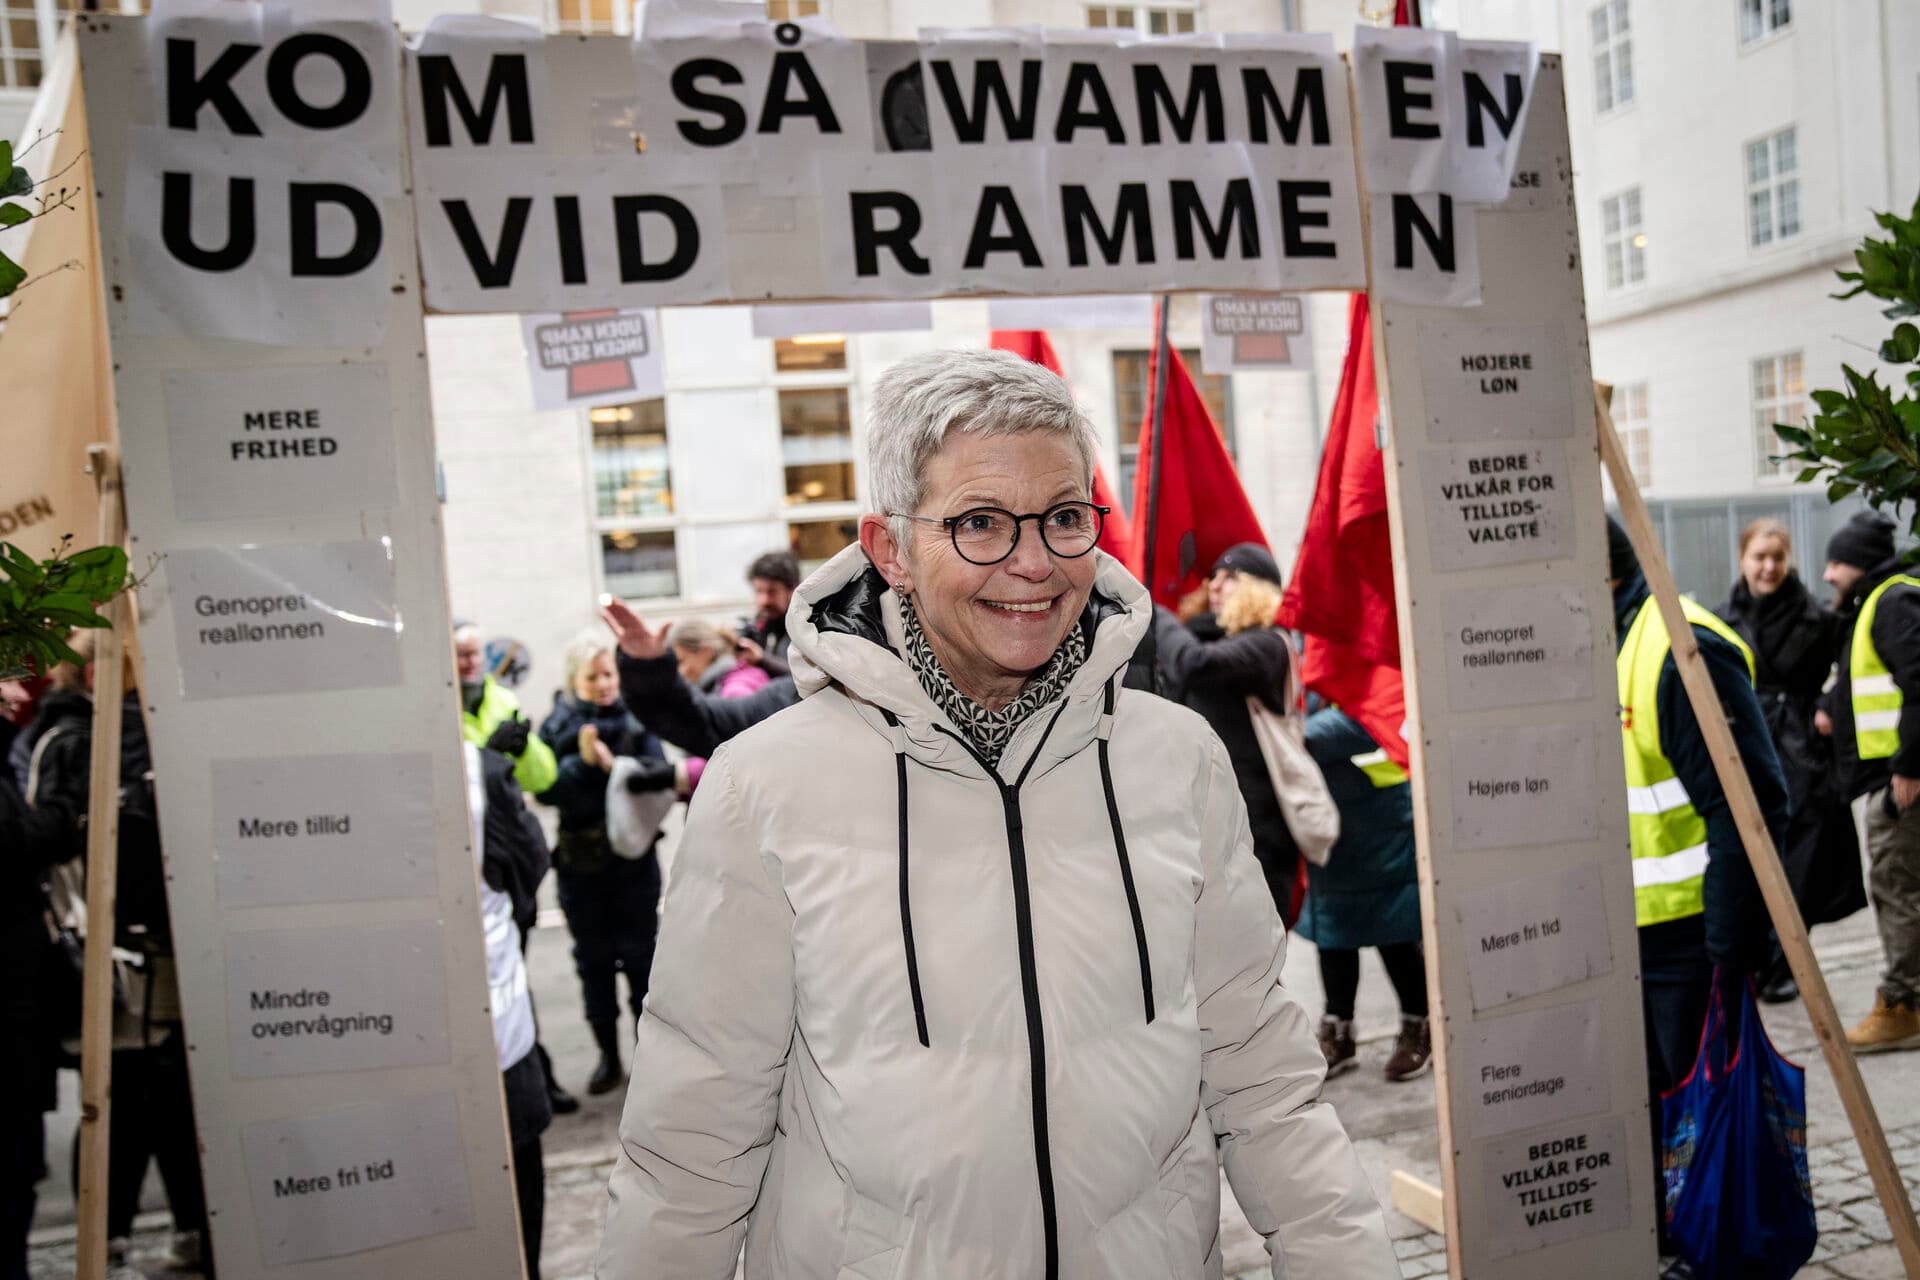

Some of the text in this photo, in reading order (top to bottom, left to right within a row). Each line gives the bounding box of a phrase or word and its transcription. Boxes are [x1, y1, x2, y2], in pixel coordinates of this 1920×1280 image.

[166, 23, 1523, 147] KOM SÅ WAMMEN
[161, 171, 1455, 287] UD VID RAMMEN
[1461, 354, 1533, 372] HØJERE
[1480, 376, 1519, 394] LØN
[244, 409, 320, 431] MERE
[230, 436, 338, 461] FRIHED
[1468, 453, 1529, 475] BEDRE
[1441, 475, 1555, 500] VILKÅR FOR
[1460, 499, 1543, 522] TILLIDS-
[1468, 520, 1540, 544] VALGTE
[1460, 625, 1534, 646] Genopret
[1462, 648, 1545, 668] reallønnen
[1468, 776, 1549, 798] Højere løn
[238, 815, 351, 838] Mere tillid
[1480, 917, 1561, 953] Mere fri tid
[250, 988, 331, 1011] Mindre
[251, 1013, 394, 1040] overvågning
[1480, 1064, 1522, 1084] Flere
[1481, 1075, 1565, 1106] seniordage
[1528, 1135, 1589, 1161] BEDRE
[273, 1160, 395, 1199] Mere fri tid
[1501, 1151, 1612, 1189] VILKÅR FOR
[1516, 1179, 1598, 1208] TILLIDS-
[1523, 1198, 1594, 1228] VALGTE
